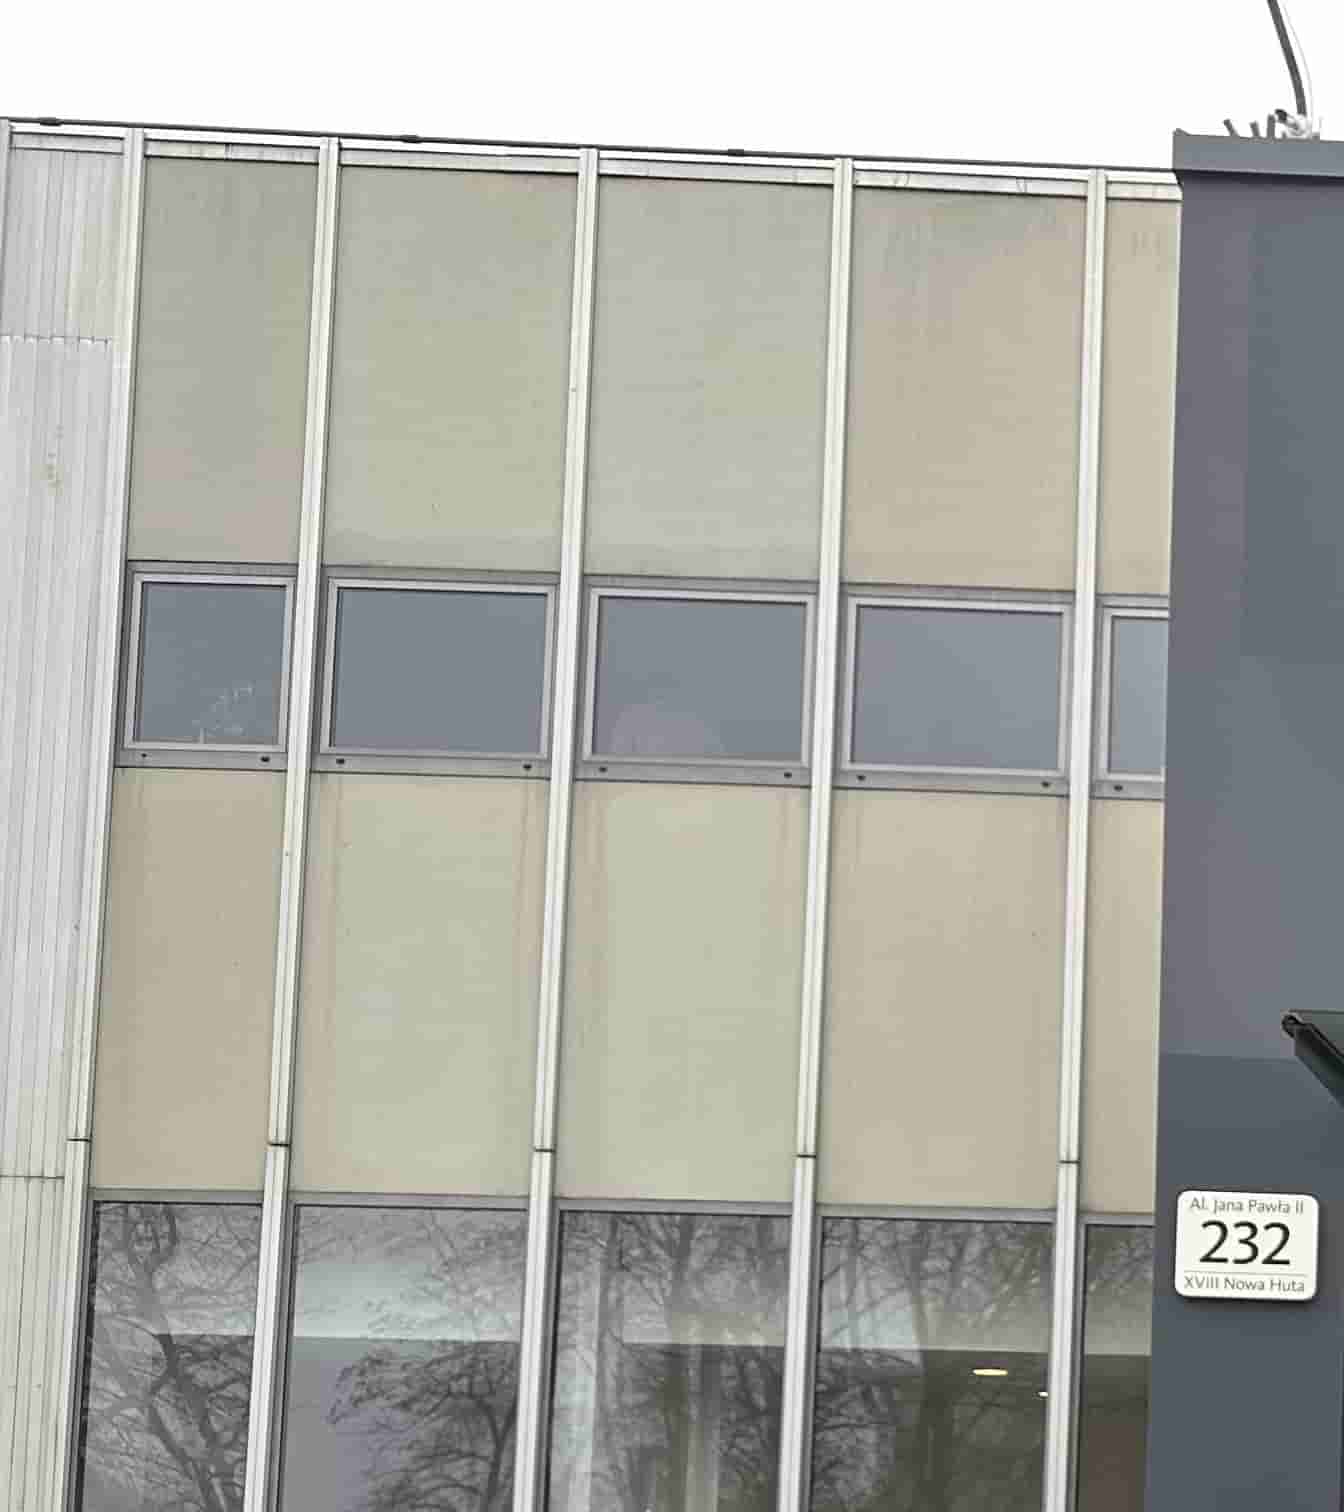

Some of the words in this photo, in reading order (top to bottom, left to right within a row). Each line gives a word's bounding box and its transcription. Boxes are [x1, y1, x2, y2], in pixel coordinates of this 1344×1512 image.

[1214, 1199, 1244, 1214] Jana
[1249, 1199, 1290, 1214] Pawła
[1295, 1200, 1304, 1215] II
[1199, 1220, 1291, 1265] 232
[1184, 1275, 1219, 1289] XVIII
[1224, 1277, 1265, 1291] Nowa
[1270, 1278, 1305, 1292] Huta
